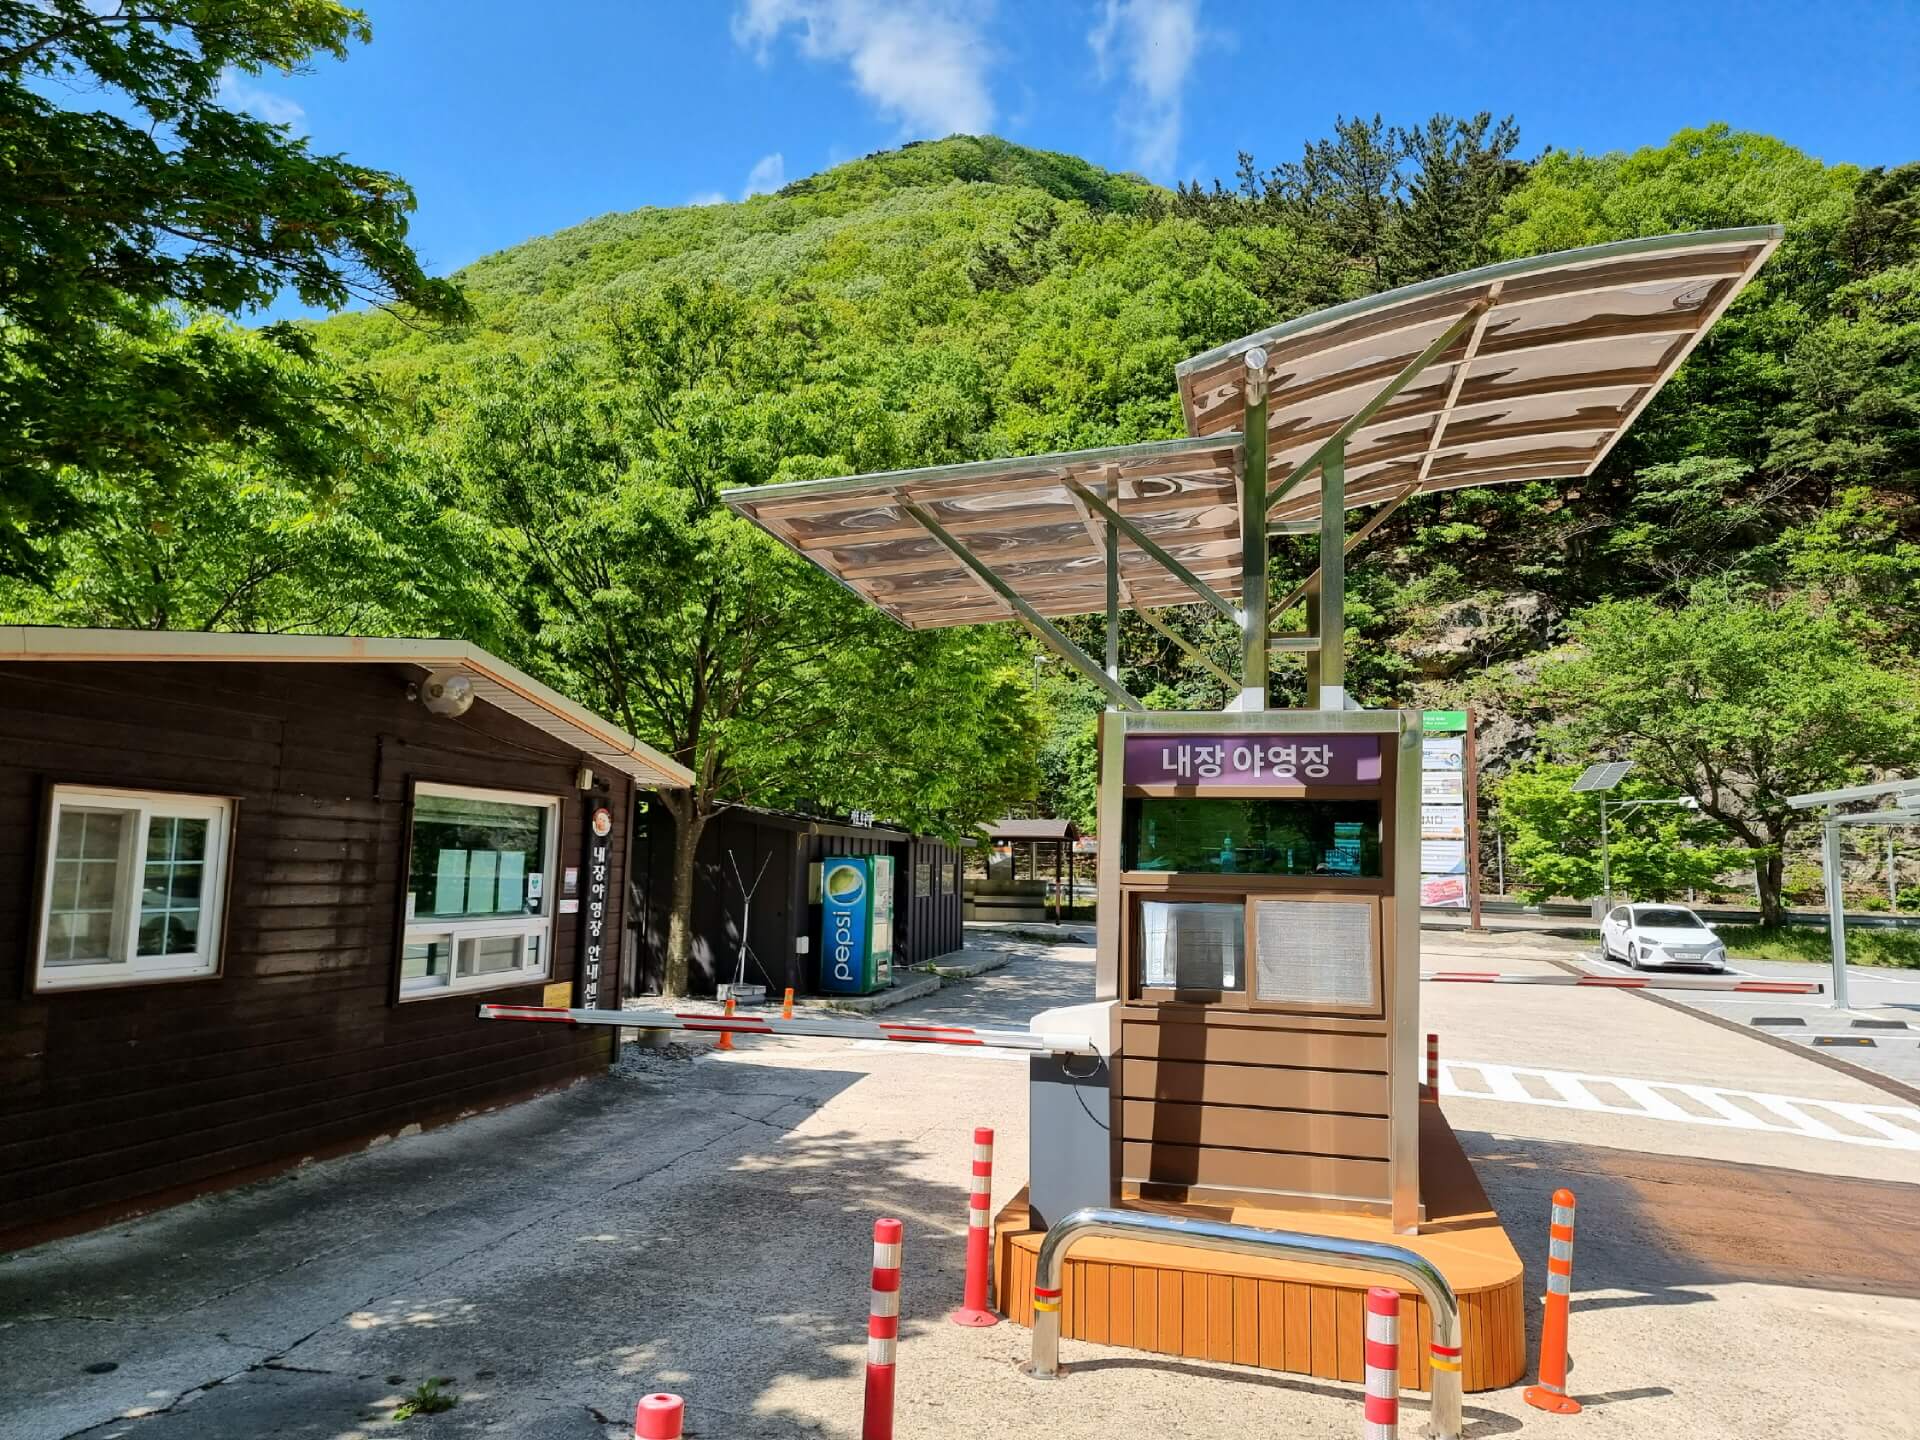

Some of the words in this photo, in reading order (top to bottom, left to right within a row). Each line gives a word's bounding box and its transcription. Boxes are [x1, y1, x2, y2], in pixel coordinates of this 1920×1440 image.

[1162, 744, 1225, 779] 내장
[1232, 744, 1334, 779] 야영장
[589, 846, 606, 937] 내장야영장
[832, 911, 854, 981] pepsi
